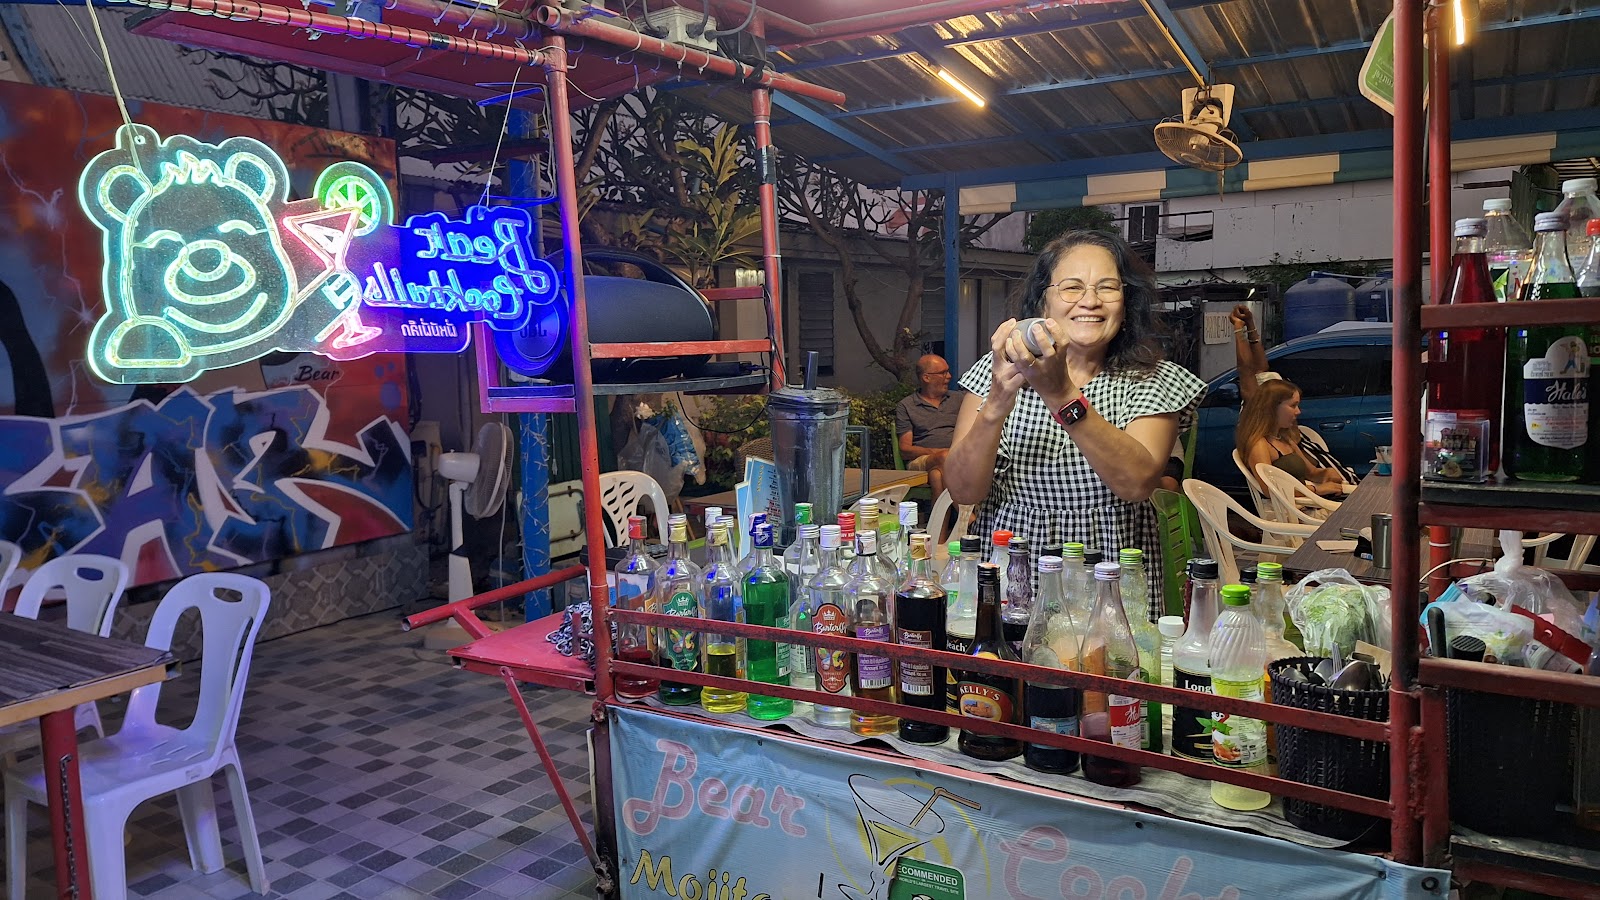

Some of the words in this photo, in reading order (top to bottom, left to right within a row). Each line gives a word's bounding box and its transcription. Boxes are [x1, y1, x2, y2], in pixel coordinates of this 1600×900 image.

[294, 365, 341, 383] Bear
[1545, 379, 1588, 402] Hale's
[959, 684, 1001, 702] KELLY'S
[1184, 680, 1212, 695] Long
[622, 738, 808, 838] Bear
[630, 849, 771, 900] Mojit
